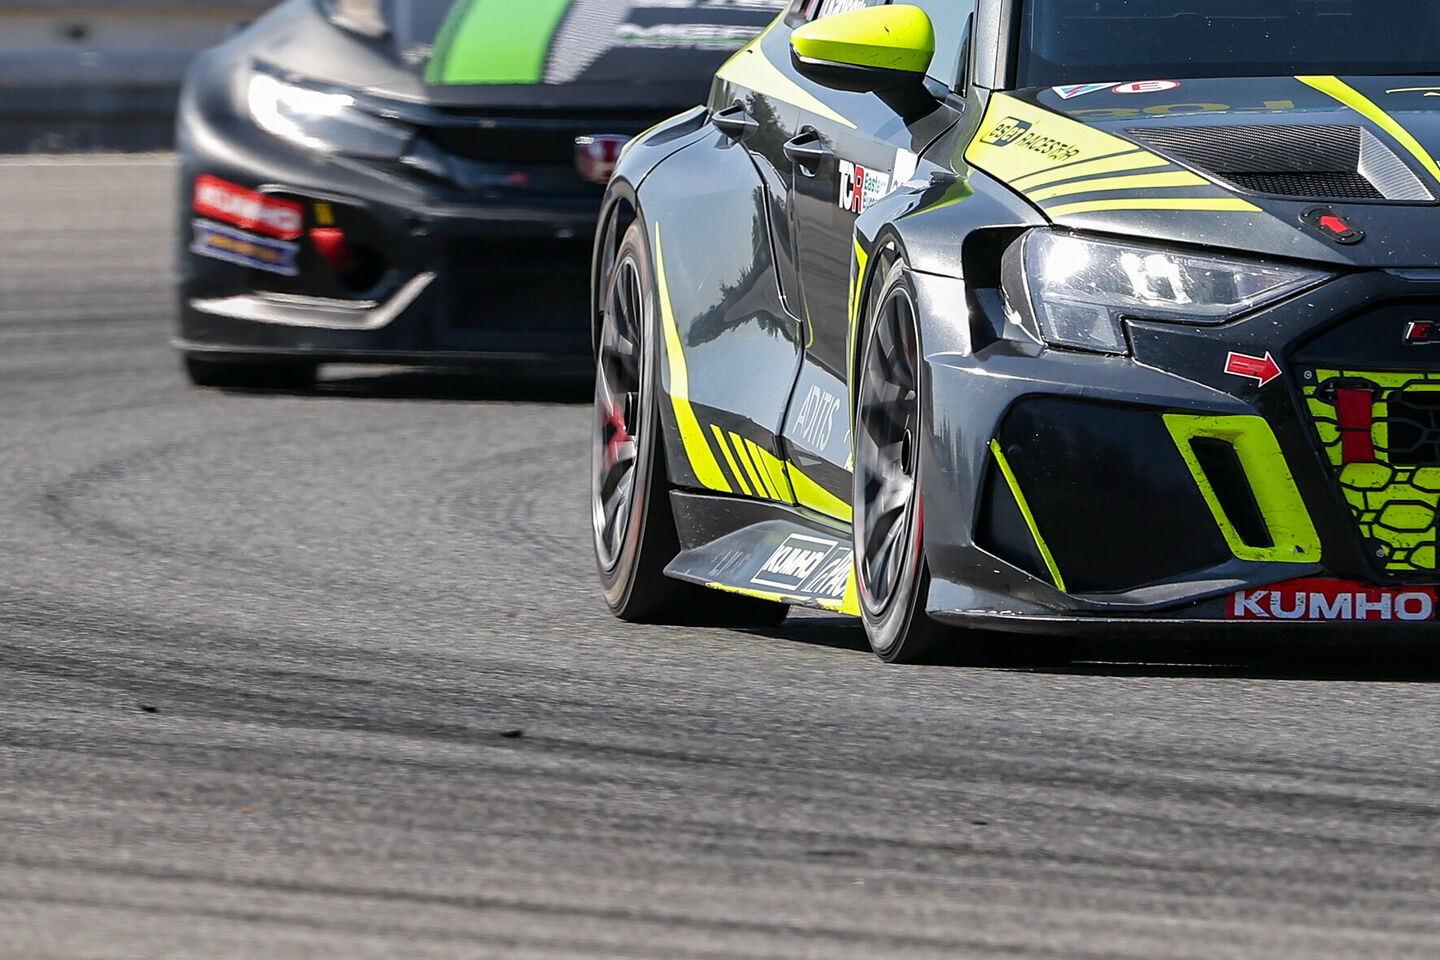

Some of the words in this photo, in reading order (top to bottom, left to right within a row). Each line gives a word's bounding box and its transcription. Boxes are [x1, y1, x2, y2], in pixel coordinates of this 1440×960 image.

[838, 159, 865, 214] TCR
[792, 384, 841, 452] ADITIS
[763, 545, 825, 579] KUMHO
[1233, 590, 1433, 621] KUMHO
